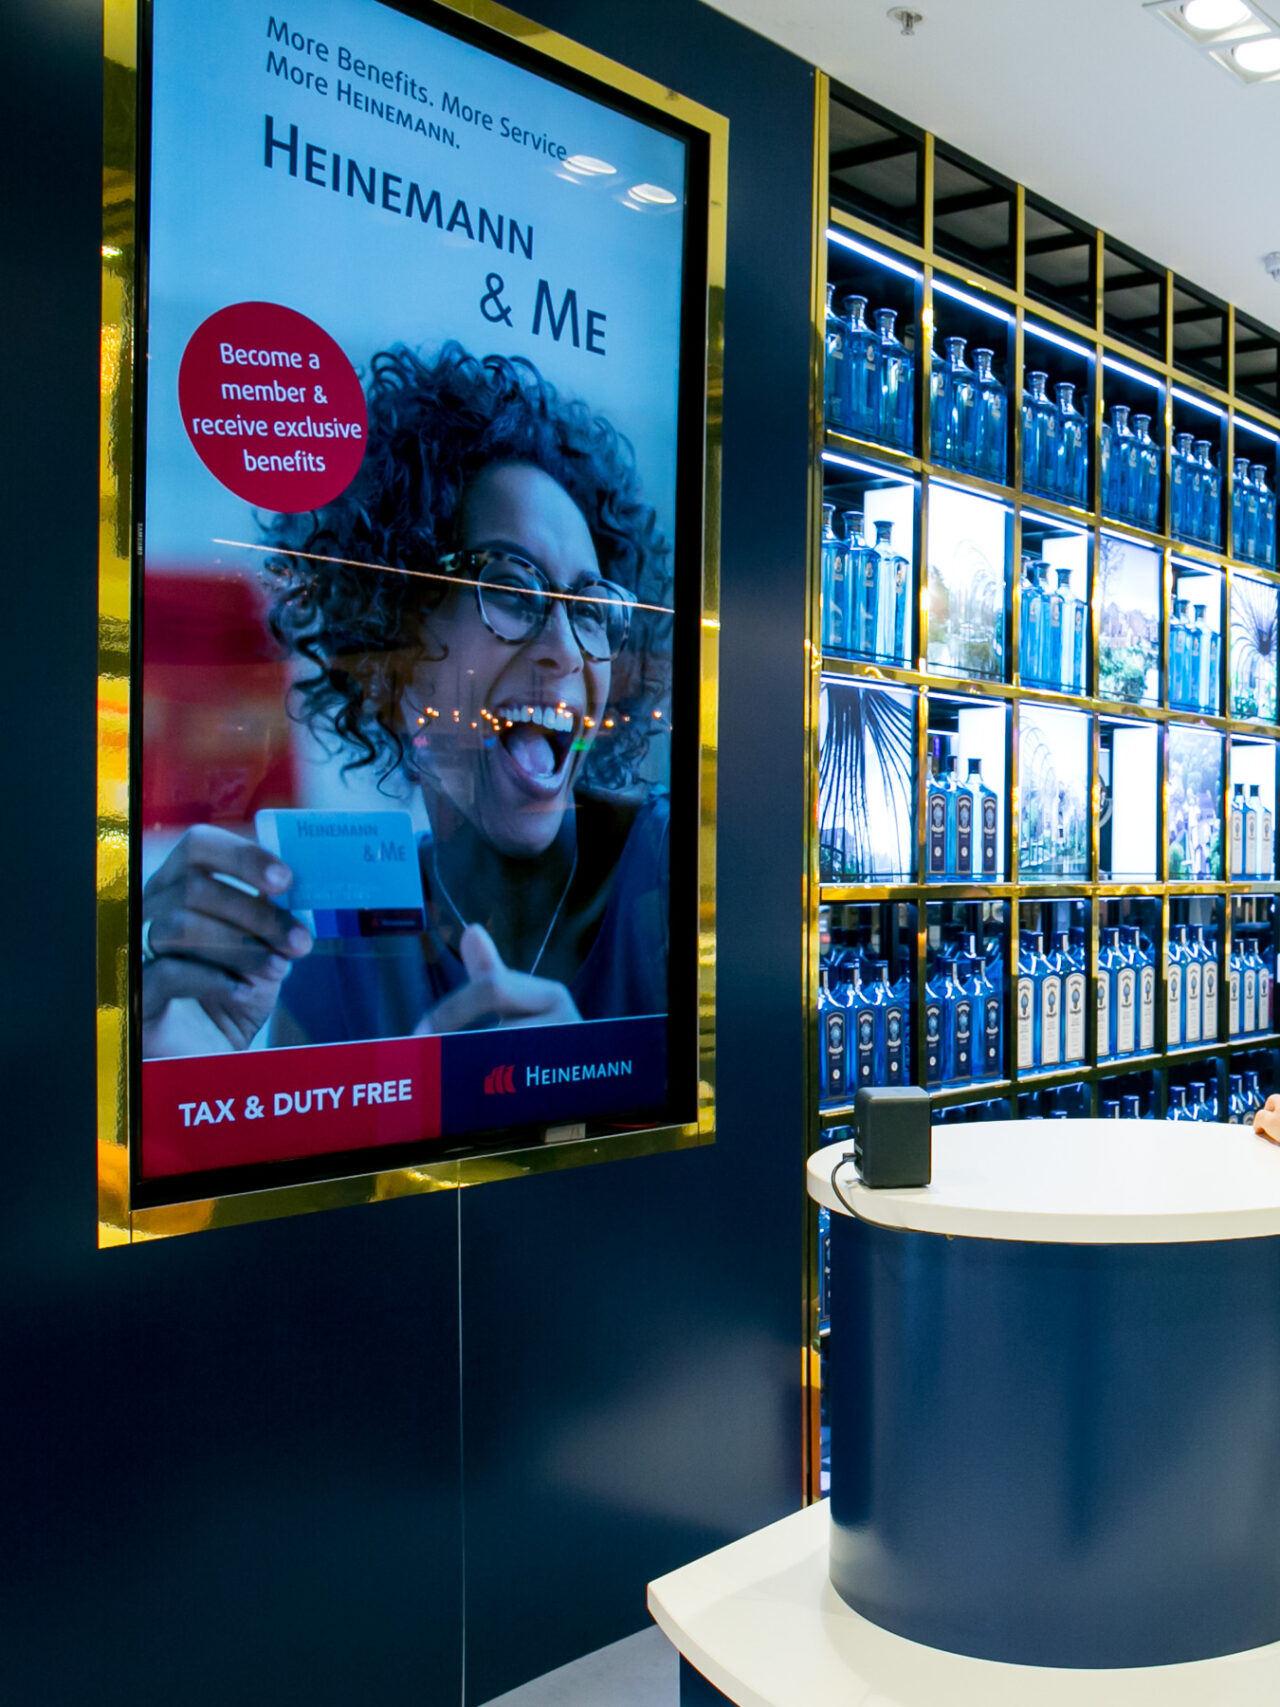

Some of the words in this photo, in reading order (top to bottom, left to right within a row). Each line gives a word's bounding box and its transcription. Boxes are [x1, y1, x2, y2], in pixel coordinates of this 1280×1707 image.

[266, 15, 329, 62] More
[337, 46, 434, 107] Benefits.
[442, 91, 493, 131] More
[266, 50, 328, 96] More
[336, 79, 460, 149] HEINEMANN.
[263, 114, 534, 260] HEINEMANN
[479, 272, 513, 328] &
[531, 279, 607, 356] ME
[219, 342, 303, 369] Become
[308, 353, 320, 370] a
[221, 379, 306, 403] member
[313, 385, 328, 404] &
[192, 412, 268, 437] receive
[273, 413, 362, 439] exclusive
[243, 448, 326, 472] benefits
[363, 845, 375, 863] &
[526, 1060, 632, 1087] HEINEMANN
[178, 1098, 236, 1127] TAX
[243, 1096, 265, 1120] &
[273, 1086, 345, 1116] DUTY
[352, 1078, 413, 1106] FREE
